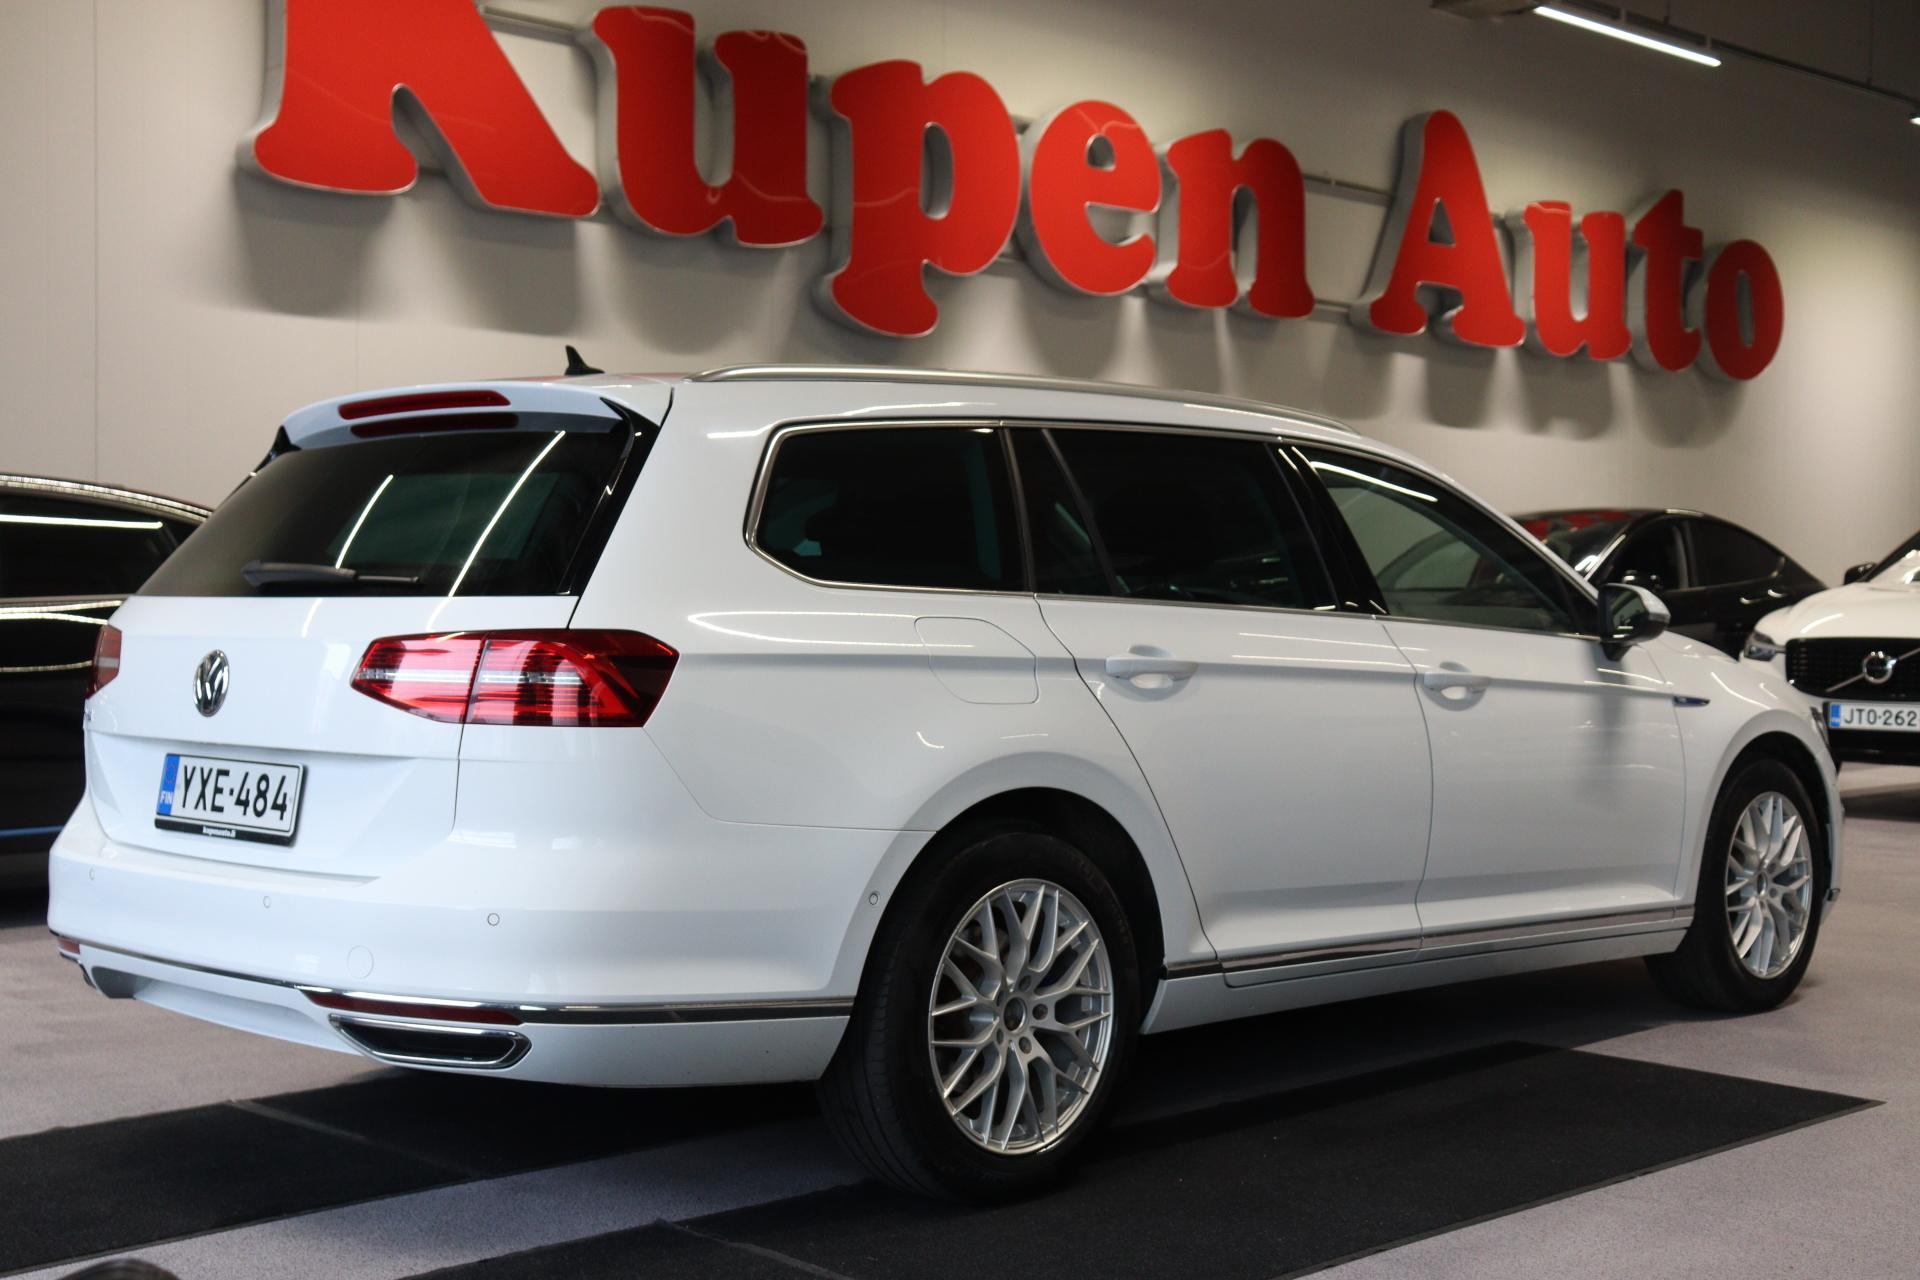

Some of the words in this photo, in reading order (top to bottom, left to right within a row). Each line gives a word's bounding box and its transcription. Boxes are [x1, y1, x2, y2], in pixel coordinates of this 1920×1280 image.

[1369, 109, 1785, 381] Auto
[1844, 707, 1918, 727] JTO-262
[160, 790, 175, 806] FIN
[182, 764, 288, 822] YXE-484
